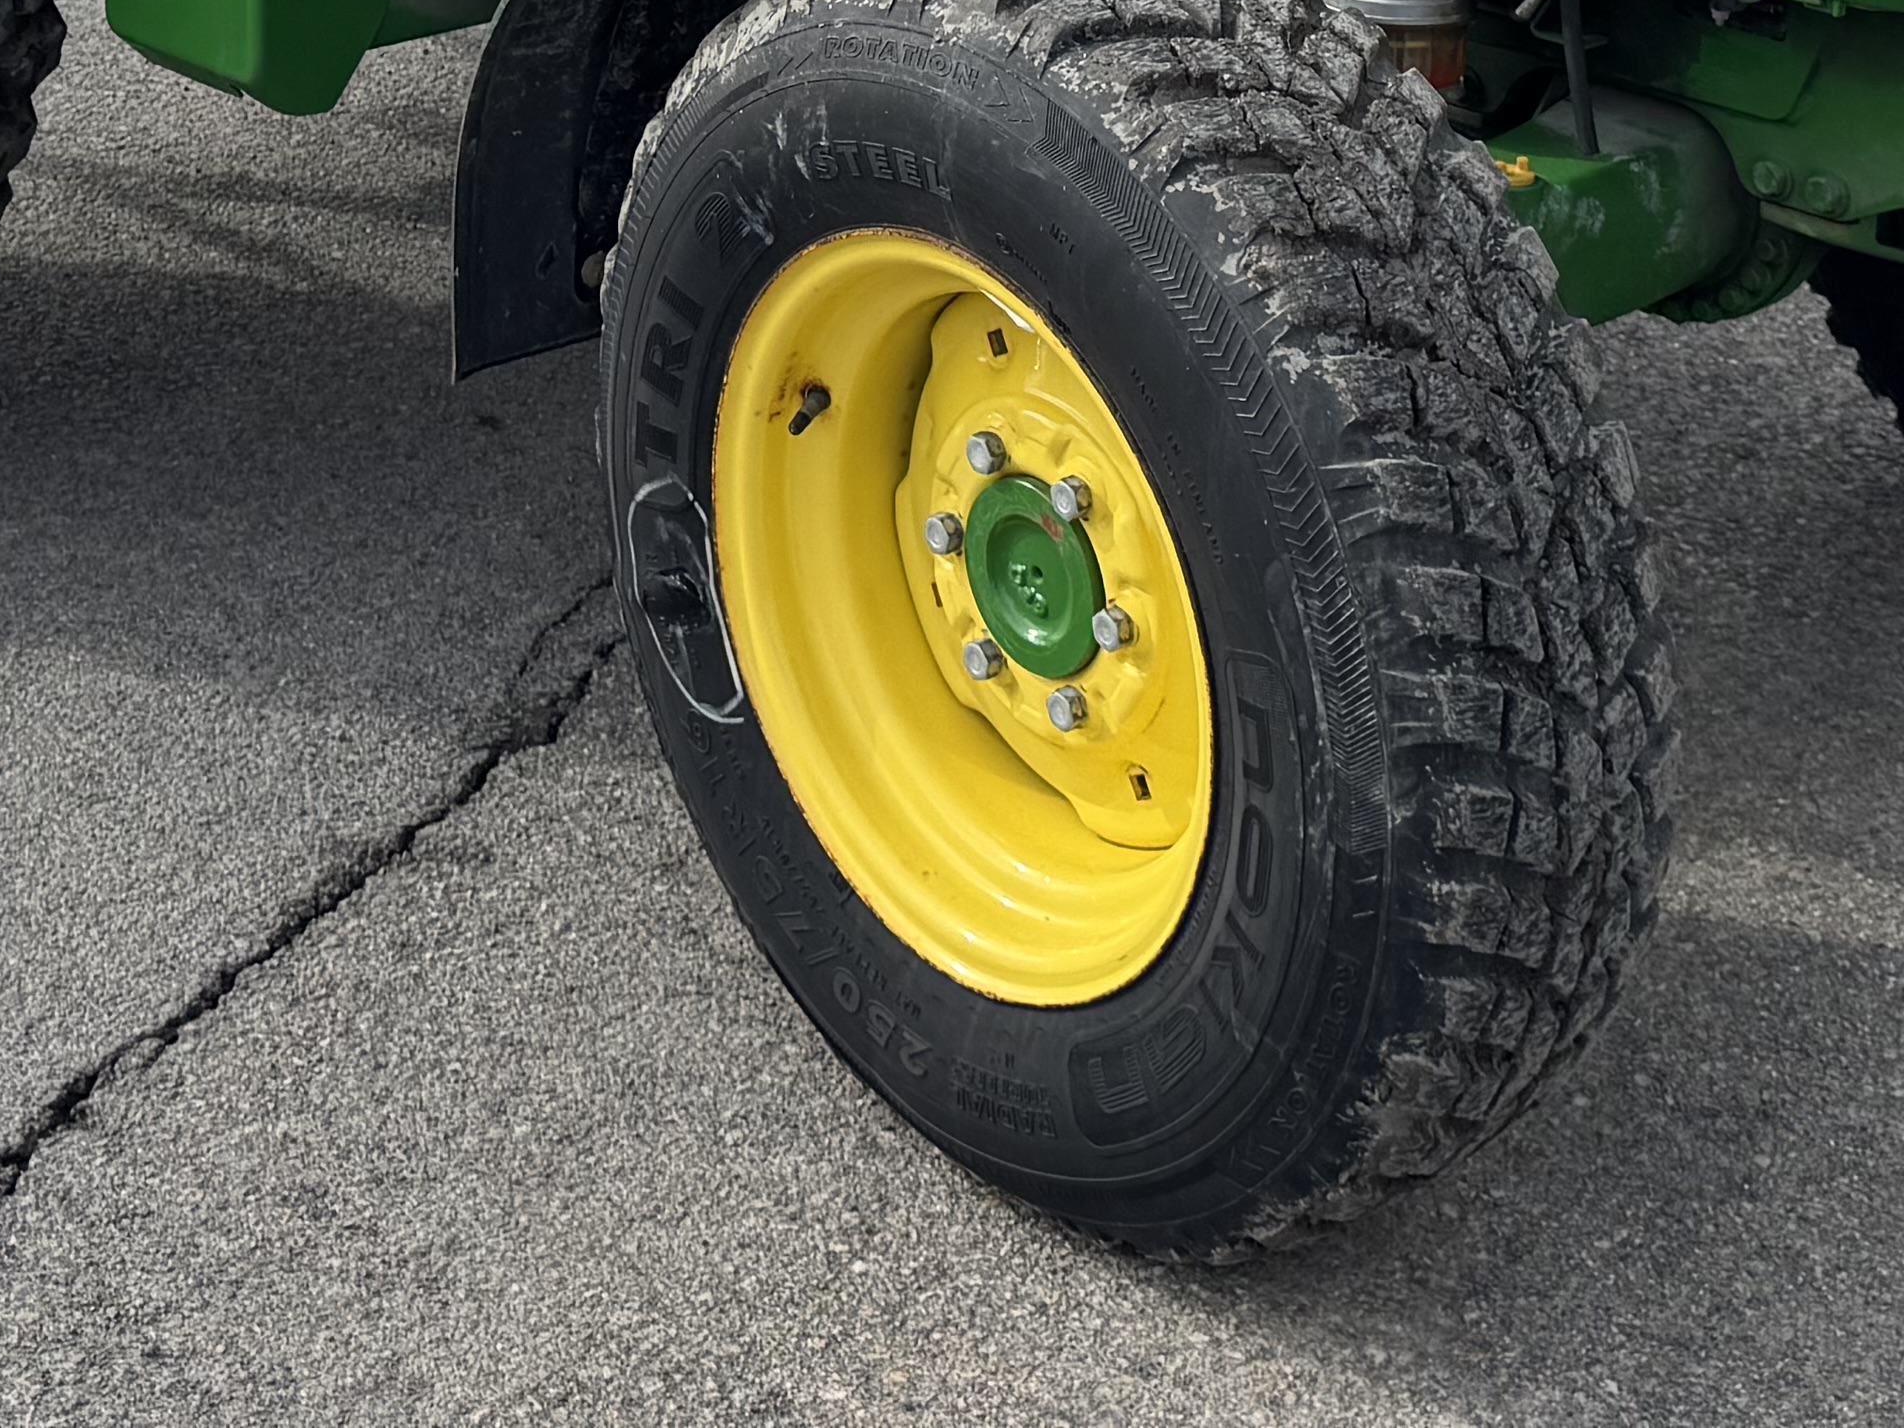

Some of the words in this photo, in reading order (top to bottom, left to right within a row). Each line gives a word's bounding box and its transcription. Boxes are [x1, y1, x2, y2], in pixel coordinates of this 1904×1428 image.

[823, 35, 980, 91] ROTATION
[811, 139, 953, 202] STEEL
[634, 274, 705, 471] TRI
[696, 191, 753, 270] 2
